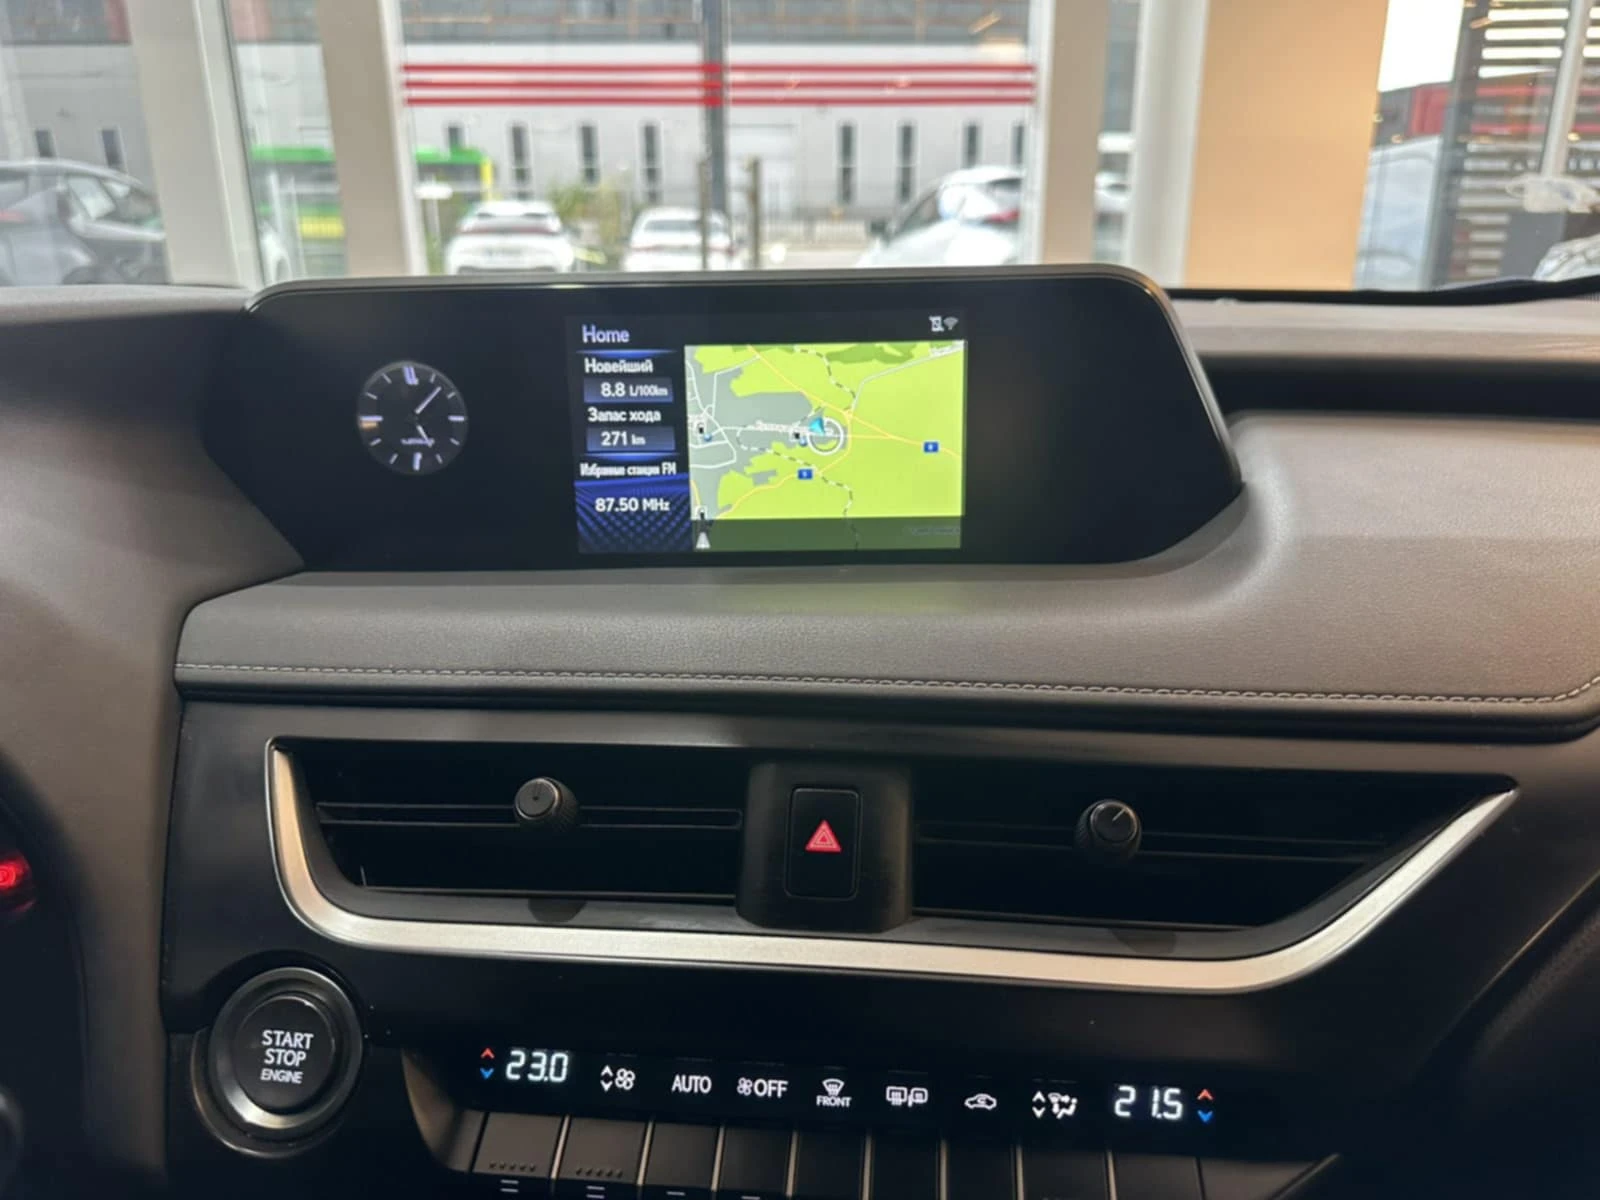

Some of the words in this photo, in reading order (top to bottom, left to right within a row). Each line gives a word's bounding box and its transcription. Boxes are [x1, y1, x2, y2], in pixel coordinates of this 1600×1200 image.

[582, 324, 630, 343] Home
[601, 382, 626, 397] 8.8
[588, 407, 627, 422] Запас
[629, 410, 662, 423] хода
[601, 431, 627, 446] 271
[595, 497, 639, 512] 87.50
[642, 498, 670, 511] MHz
[262, 1029, 314, 1050] START
[263, 1048, 307, 1067] STOP
[505, 1049, 569, 1083] 23.0
[260, 1069, 303, 1084] ENGINE
[671, 1075, 712, 1095] AUTO
[754, 1079, 788, 1099] OFF
[816, 1095, 851, 1108] FRONT
[1114, 1085, 1183, 1120] 21.5
